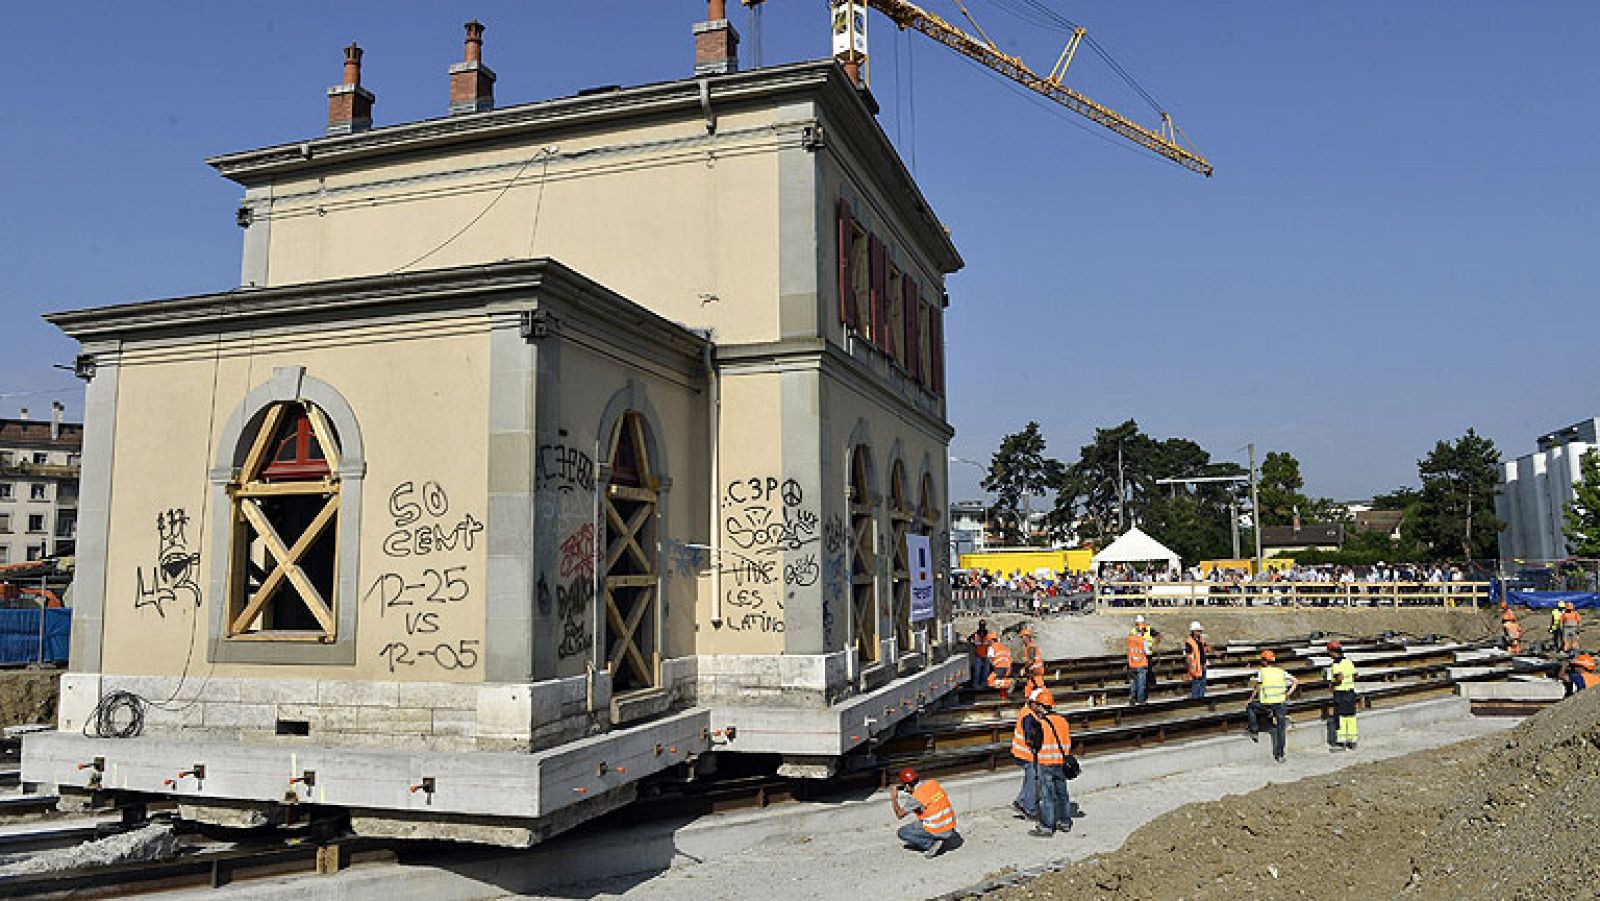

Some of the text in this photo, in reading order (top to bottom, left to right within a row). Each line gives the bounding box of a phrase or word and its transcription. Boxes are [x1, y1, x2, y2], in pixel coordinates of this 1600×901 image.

[389, 481, 448, 527] 50
[364, 565, 469, 617] 12-25
[727, 589, 763, 609] LES
[379, 639, 479, 672] 12-05
